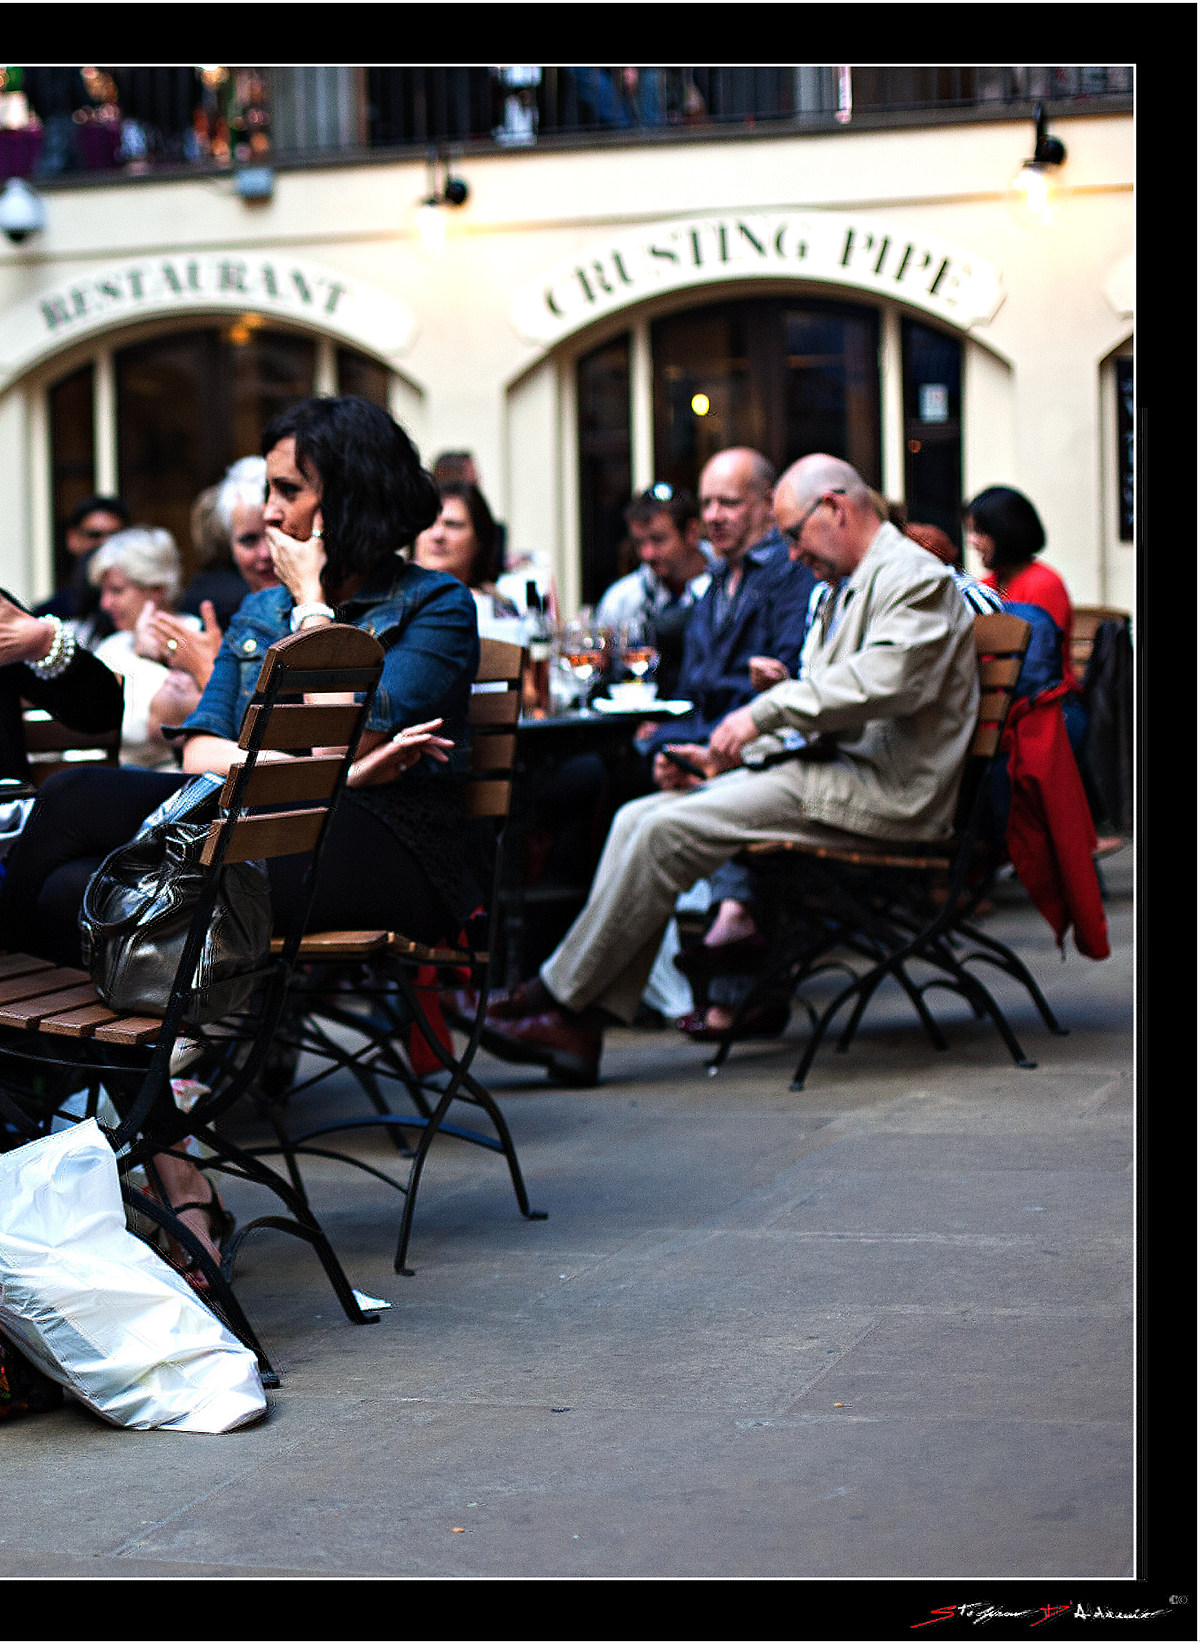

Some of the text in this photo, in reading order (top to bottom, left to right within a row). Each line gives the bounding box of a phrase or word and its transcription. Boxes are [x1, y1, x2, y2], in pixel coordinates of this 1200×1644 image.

[38, 256, 352, 331] RESTAURANT
[542, 205, 978, 319] CRUSTING PIPE
